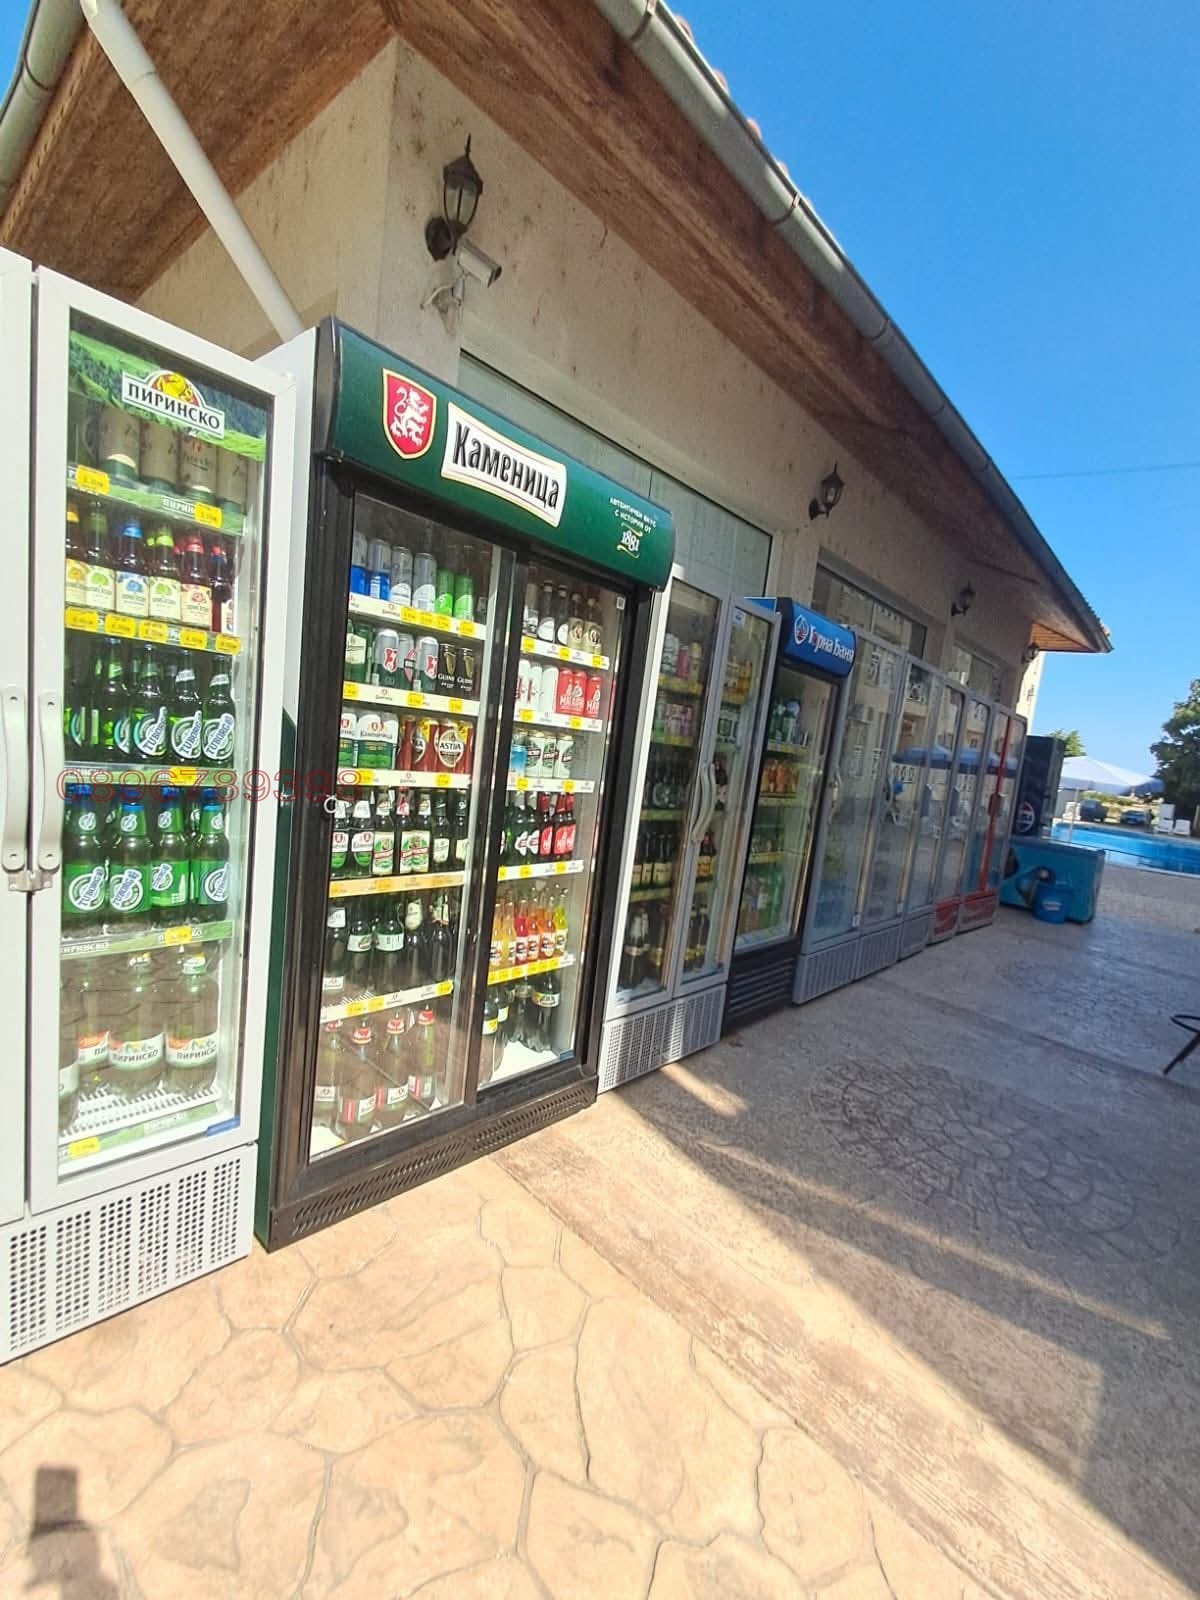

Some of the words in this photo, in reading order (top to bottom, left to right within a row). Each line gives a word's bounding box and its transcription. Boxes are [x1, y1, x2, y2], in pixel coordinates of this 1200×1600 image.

[127, 381, 221, 431] ПИРИНСКО
[452, 420, 560, 510] Каменица
[620, 530, 640, 552] 1881
[112, 1048, 159, 1063] ПИРИНСКО
